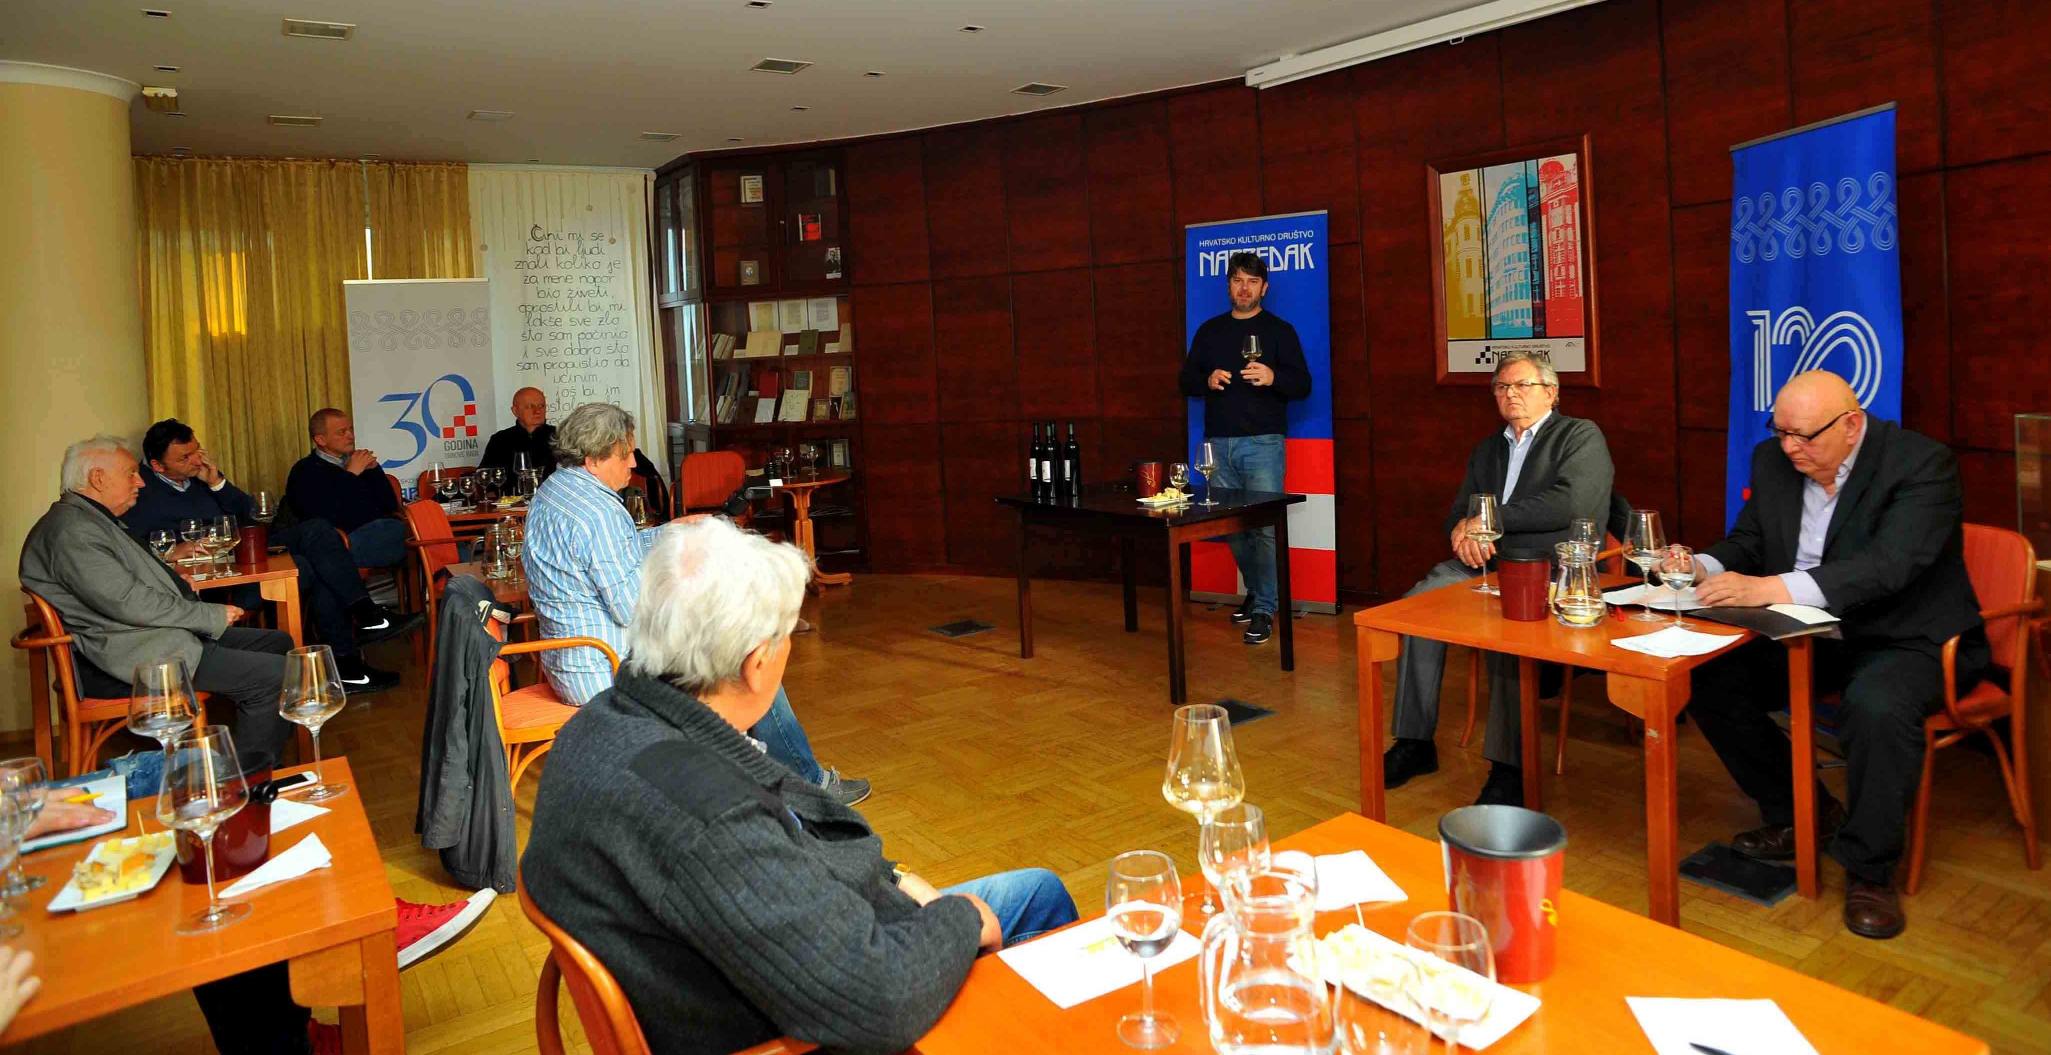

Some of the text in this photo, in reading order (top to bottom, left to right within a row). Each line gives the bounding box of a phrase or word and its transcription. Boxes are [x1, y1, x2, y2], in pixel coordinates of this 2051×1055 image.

[591, 232, 604, 241] se
[1199, 230, 1314, 248] HRVATSKO KULTURNO DRUŠTVO
[526, 241, 551, 255] kad
[555, 241, 570, 255] bi
[556, 254, 601, 270] koliko
[608, 260, 621, 273] je
[1199, 243, 1315, 276] NAEDAK
[523, 275, 616, 286] za mene napor
[536, 283, 560, 298] bio
[588, 300, 602, 312] bi
[569, 316, 591, 327] sve
[598, 310, 620, 326] zlo
[549, 331, 573, 341] sam
[536, 346, 559, 358] sve
[564, 342, 601, 356] dobro
[516, 361, 539, 372] sam
[614, 355, 630, 367] da
[378, 373, 477, 468] 30
[444, 439, 478, 451] GODINA
